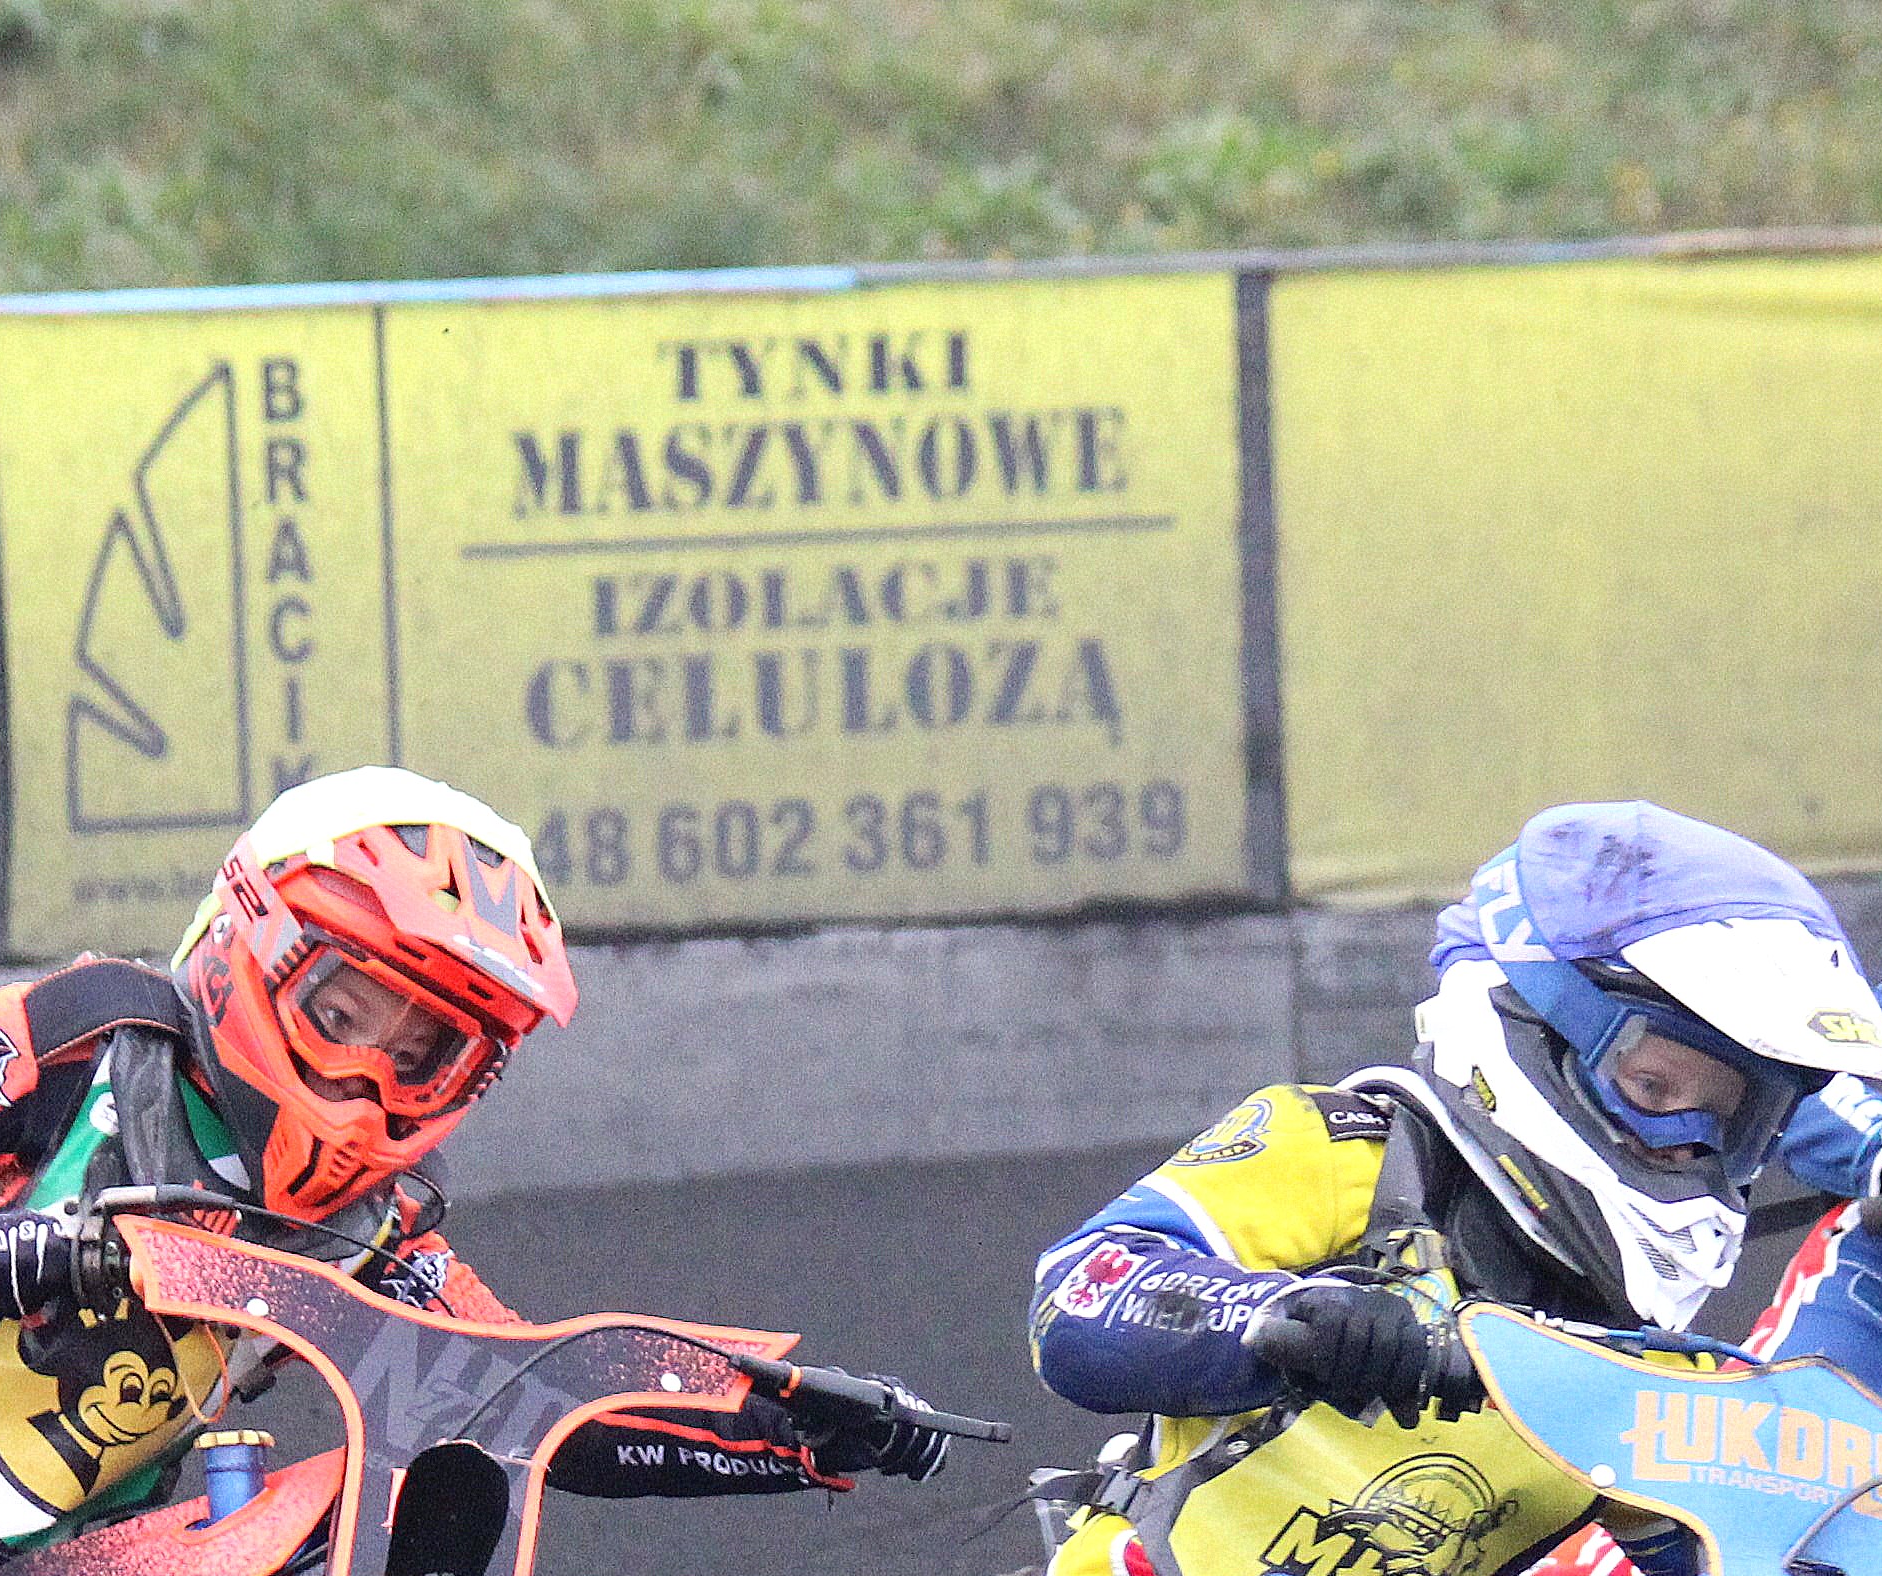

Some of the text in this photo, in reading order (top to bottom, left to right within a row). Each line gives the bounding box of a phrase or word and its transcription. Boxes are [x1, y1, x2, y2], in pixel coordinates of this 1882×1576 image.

[659, 331, 971, 402] TYNKI
[512, 406, 1129, 519] MASZYNOWE
[593, 556, 1060, 640] IZOLACJE
[525, 638, 1123, 752] CELULOZĄ
[655, 798, 816, 885] 602
[844, 788, 991, 872] 361
[1024, 778, 1188, 866] 939
[617, 1444, 666, 1467] KW
[1694, 1465, 1844, 1508] TRANSPORT
